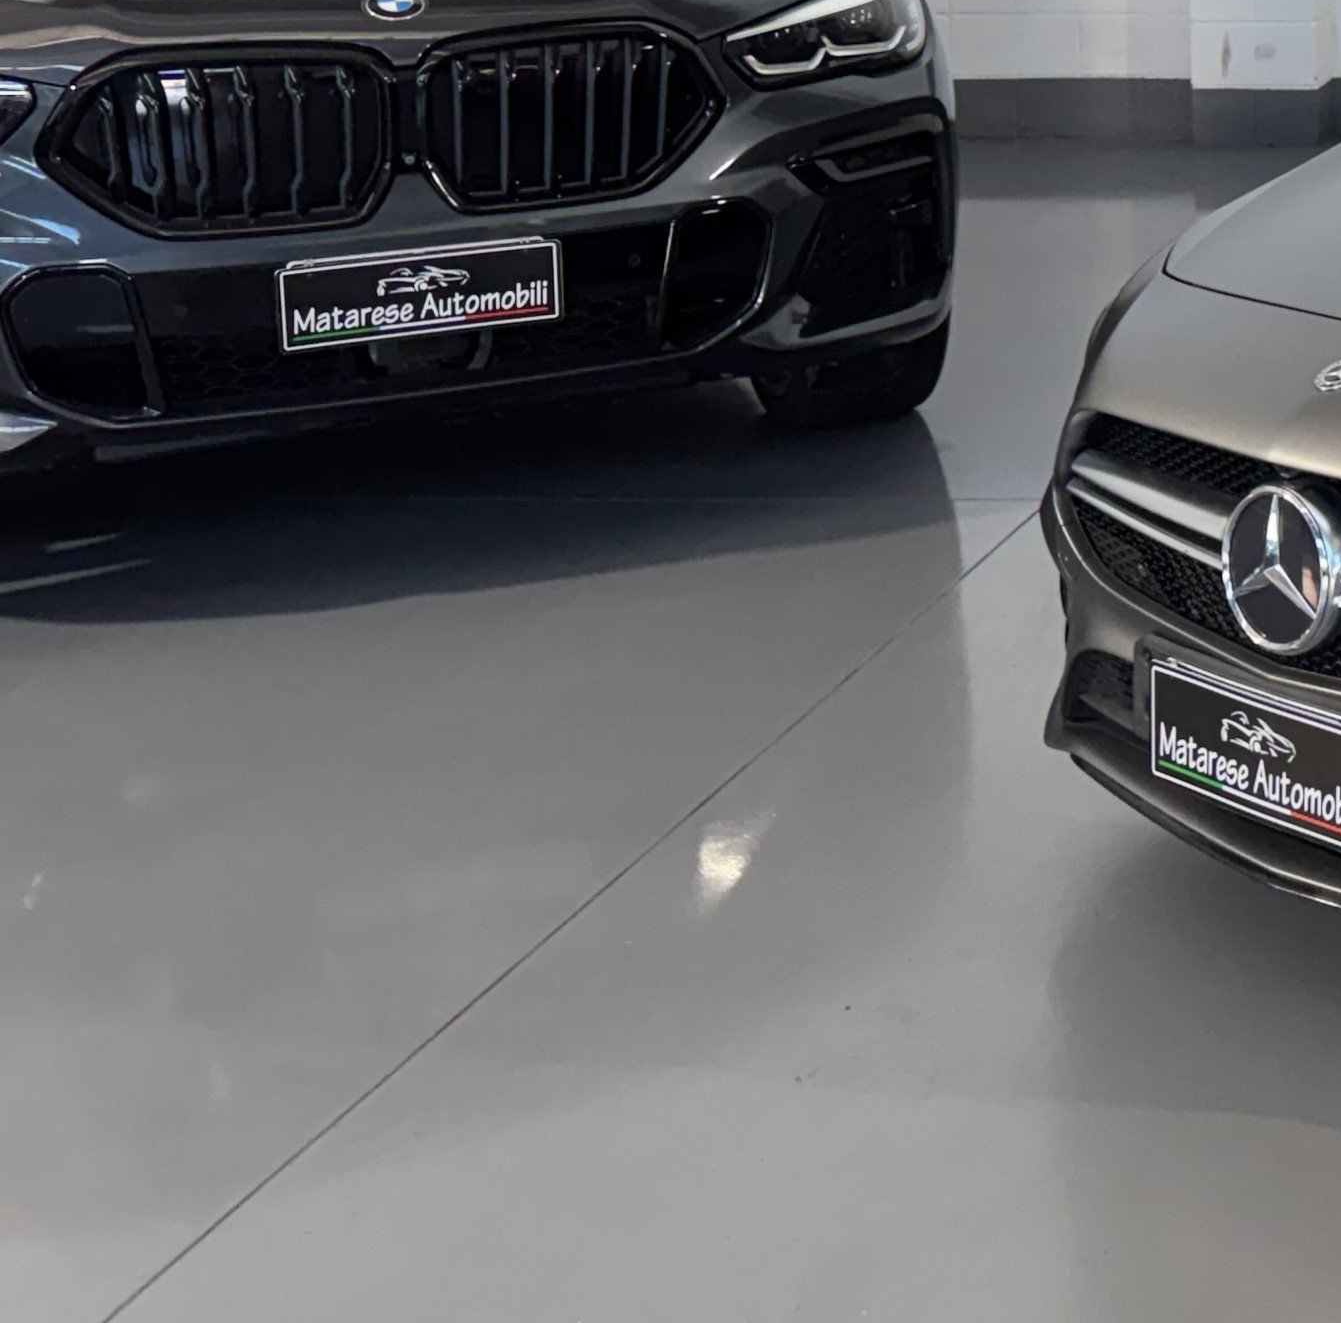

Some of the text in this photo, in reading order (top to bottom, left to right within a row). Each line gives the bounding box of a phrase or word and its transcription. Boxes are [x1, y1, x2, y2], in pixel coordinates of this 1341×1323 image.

[293, 280, 549, 335] Matarese Automobili
[1159, 721, 1249, 790] Matarese
